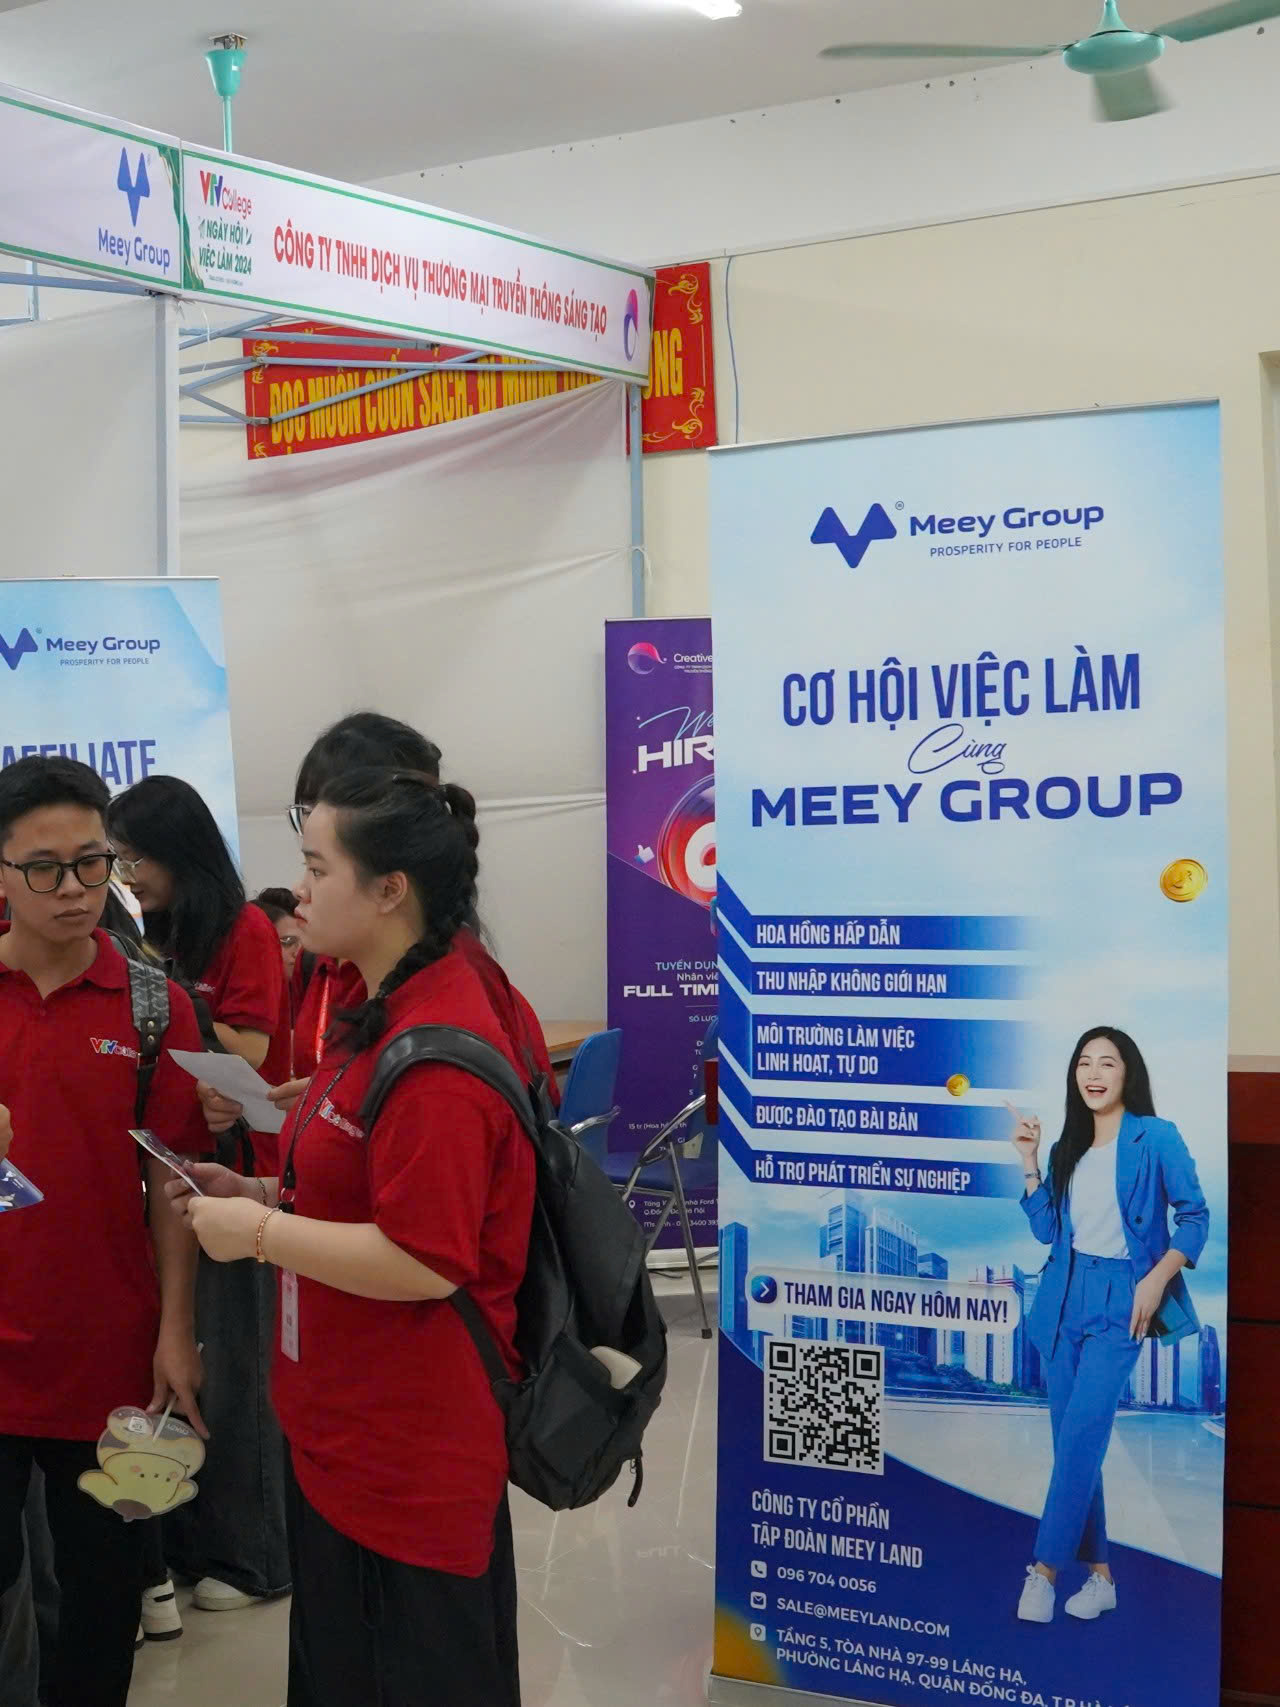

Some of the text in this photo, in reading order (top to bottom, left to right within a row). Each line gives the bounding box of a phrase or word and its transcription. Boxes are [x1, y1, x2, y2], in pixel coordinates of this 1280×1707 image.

[206, 217, 243, 249] NGÀY HỘI
[98, 228, 170, 274] Meey Group
[199, 243, 252, 275] VIỆC LÀM 2024
[274, 218, 607, 342] CÔNG TY TNHH DỊCH VỤ THƯƠNG MẠI TRUYỀN THÔNG SÁNG TẠO
[910, 506, 1104, 538] Meey Group
[930, 537, 1082, 557] PROSPERITY FOR PEOPLE
[46, 636, 160, 655] Meey Group
[60, 658, 104, 666] PROSPERITY
[123, 657, 149, 665] PEOPLE
[782, 644, 1140, 731] CƠ HỘI VIỆC LÀM
[907, 723, 1007, 775] Cùng
[751, 772, 1183, 827] MEEY GROUP
[756, 919, 900, 945] HOA HỒNG HẤP DẪN
[677, 973, 703, 981] Nhân
[695, 961, 718, 971] DỤN
[624, 984, 719, 997] FULL TIM
[756, 969, 947, 996] THU NHẬP KHÔNG GIỚI HẠN
[757, 1023, 915, 1052] MÔI TRƯỜNG LÀM VIỆC
[757, 1053, 878, 1077] LINH HOẠT, TỰ DO
[756, 1105, 918, 1131] ĐƯỢC ĐÀO TẠO BÀI BẢN
[755, 1154, 971, 1194] HỖ TRỢ PHÁT TRIỂN SỰ NGHIỆP
[784, 1282, 1008, 1323] THAM GIA NGAY HÔM NAY!
[751, 1489, 890, 1530] CÔNG TY CỔ PHẦN
[751, 1521, 923, 1569] TẬP ĐOÀN MEEY LAND
[777, 1566, 877, 1594] 096 704 0056
[776, 1597, 950, 1638] SALE@MEEYLAND.COM
[776, 1626, 1027, 1686] TẦNG 5, TÒA NHÀ 97-99 LÁNG HẠ,
[776, 1648, 840, 1671] PHƯỜNG
[844, 1660, 885, 1680] LÁNG
[889, 1669, 915, 1687] HẠ,
[920, 1673, 966, 1694] QUẬN
[970, 1680, 1016, 1702] ĐỐNG
